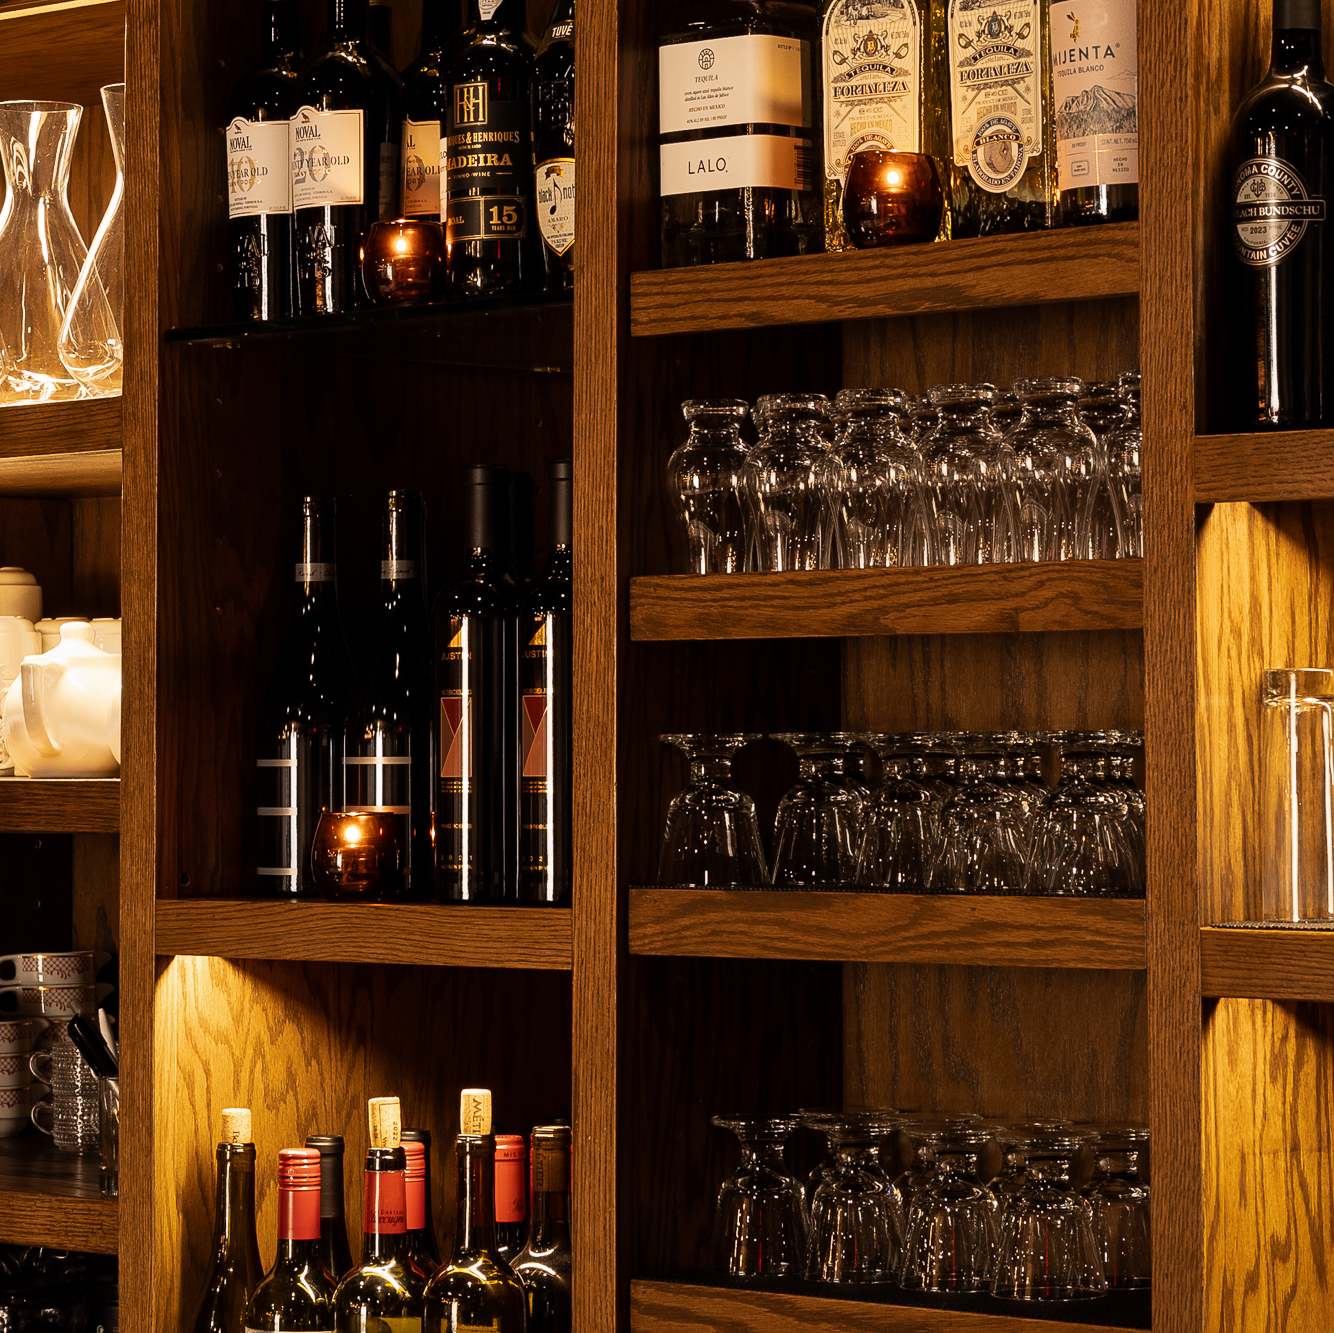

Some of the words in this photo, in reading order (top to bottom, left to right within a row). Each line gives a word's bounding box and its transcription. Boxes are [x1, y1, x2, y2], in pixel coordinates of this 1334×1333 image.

[974, 44, 1018, 61] TEQUILA
[1053, 45, 1115, 66] MIJENTA
[848, 63, 894, 78] TEQUILA
[959, 61, 1033, 83] FORTALEZA
[1078, 64, 1105, 74] BLANCO
[833, 81, 911, 100] FORTALEZA
[295, 125, 321, 140] NOVAL
[979, 134, 1017, 145] BLANCO
[229, 136, 252, 151] NOVAL
[293, 145, 331, 185] 20
[1260, 164, 1301, 196] COUNTY
[489, 205, 518, 224] 15
[1258, 205, 1320, 217] BUNDSCHU
[1249, 226, 1267, 235] 2023
[472, 1097, 482, 1135] MÉTI
